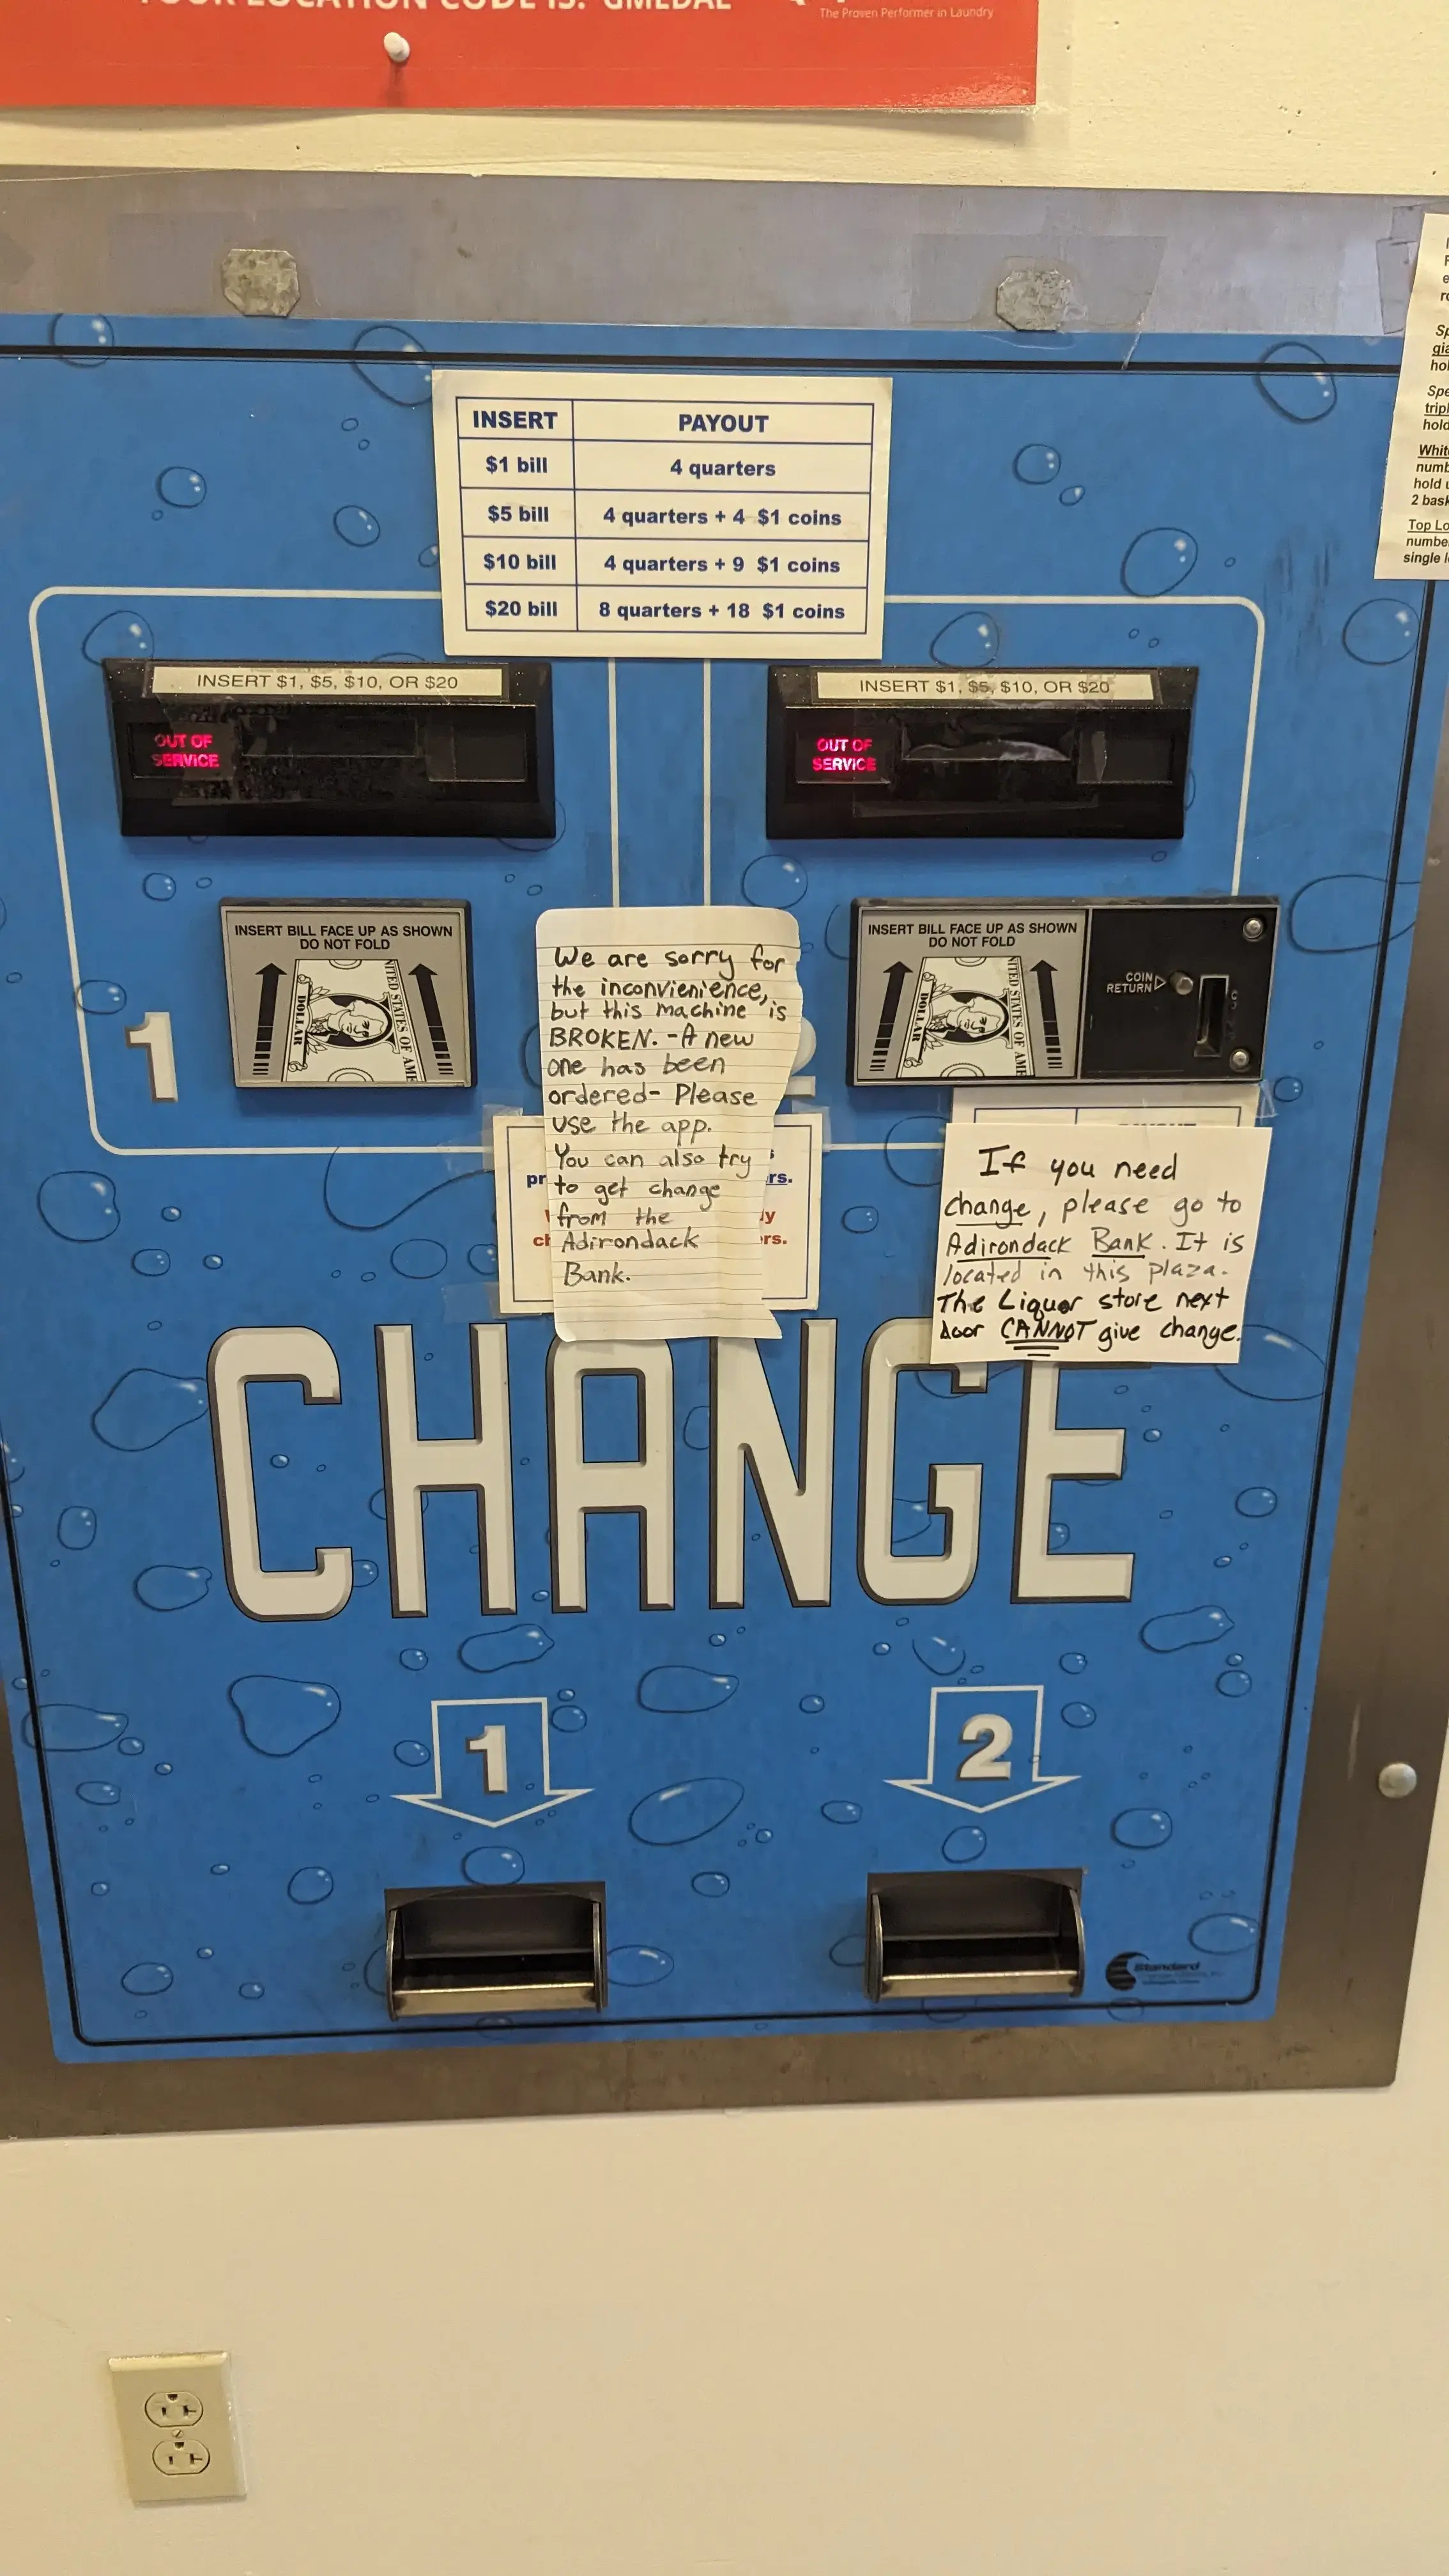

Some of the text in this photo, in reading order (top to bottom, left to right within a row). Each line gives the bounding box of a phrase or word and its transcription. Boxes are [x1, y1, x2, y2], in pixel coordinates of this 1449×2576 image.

[820, 6, 993, 19] The Proven Performer in Laundry
[473, 411, 769, 433] INSERT PAYOUT
[486, 456, 776, 479] $1 bill 4 quarters
[1414, 478, 1441, 489] hold
[1411, 494, 1418, 505] 2
[488, 505, 841, 527] $5 bill 4 quarters + 4 $1 coins
[1409, 519, 1431, 533] Top
[1406, 537, 1449, 547] numbe
[484, 553, 839, 574] $10 bill 4 quarters + 9 $1 coins
[1404, 552, 1441, 565] single
[486, 600, 845, 621] $20 bill 8 quarters + 18 $1 coins
[198, 675, 457, 690] INSERT $1, $5, $10, OR $20
[861, 680, 1109, 696] INSERT $1, $5, $10, OR $20
[155, 733, 213, 748] OUT OF
[817, 738, 873, 753] OUT OF
[151, 753, 219, 768] SERVICE
[813, 757, 876, 772] SERVICE
[235, 925, 452, 937] INSERT BILL FACE UP AS SHOWN
[869, 923, 1077, 935] INSERT BILL FACE UP AS SHOWN
[300, 939, 390, 949] DO NOT FOLD
[930, 936, 1015, 947] DO NOT FOLD
[555, 944, 785, 980] We are sorry for
[552, 975, 586, 997] the
[1107, 983, 1151, 993] RETURN
[1126, 972, 1153, 982] COIN
[293, 995, 306, 1045] DOLLAR
[551, 1000, 787, 1020] but this machine is
[912, 993, 929, 1043] DOLLAR
[1009, 991, 1023, 1027] STATES
[390, 994, 406, 1032] STATES
[399, 1037, 412, 1053] OF
[549, 1027, 659, 1050] BROKEN.
[706, 1032, 755, 1046] new
[1013, 1032, 1025, 1048] OF
[126, 1011, 178, 1103] 1
[547, 1053, 726, 1077] one has been
[675, 1085, 758, 1106] Please
[552, 1112, 712, 1146] use the app.
[555, 1142, 589, 1170] You
[604, 1153, 643, 1168] can
[659, 1150, 705, 1167] also
[718, 1144, 751, 1179] try
[979, 1145, 1177, 1186] If you need
[555, 1174, 579, 1195] to
[594, 1176, 629, 1206] get
[648, 1177, 721, 1211] change
[557, 1201, 606, 1228] from
[636, 1207, 671, 1226] the
[944, 1189, 1242, 1229] change, please go to
[562, 1227, 699, 1253] Adirondack
[946, 1232, 1072, 1257] Adirondack
[1176, 1230, 1208, 1252] It
[1223, 1233, 1245, 1254] is
[564, 1261, 631, 1287] Bank.
[943, 1259, 1229, 1286] located in this plaza.
[937, 1286, 1230, 1321] The Liquor store next
[1001, 1318, 1098, 1341] CANNOT
[1098, 1323, 1140, 1353] give
[1160, 1315, 1242, 1349] change.
[207, 1317, 1135, 1623] CHANGE
[466, 1713, 1014, 1793] 1 2
